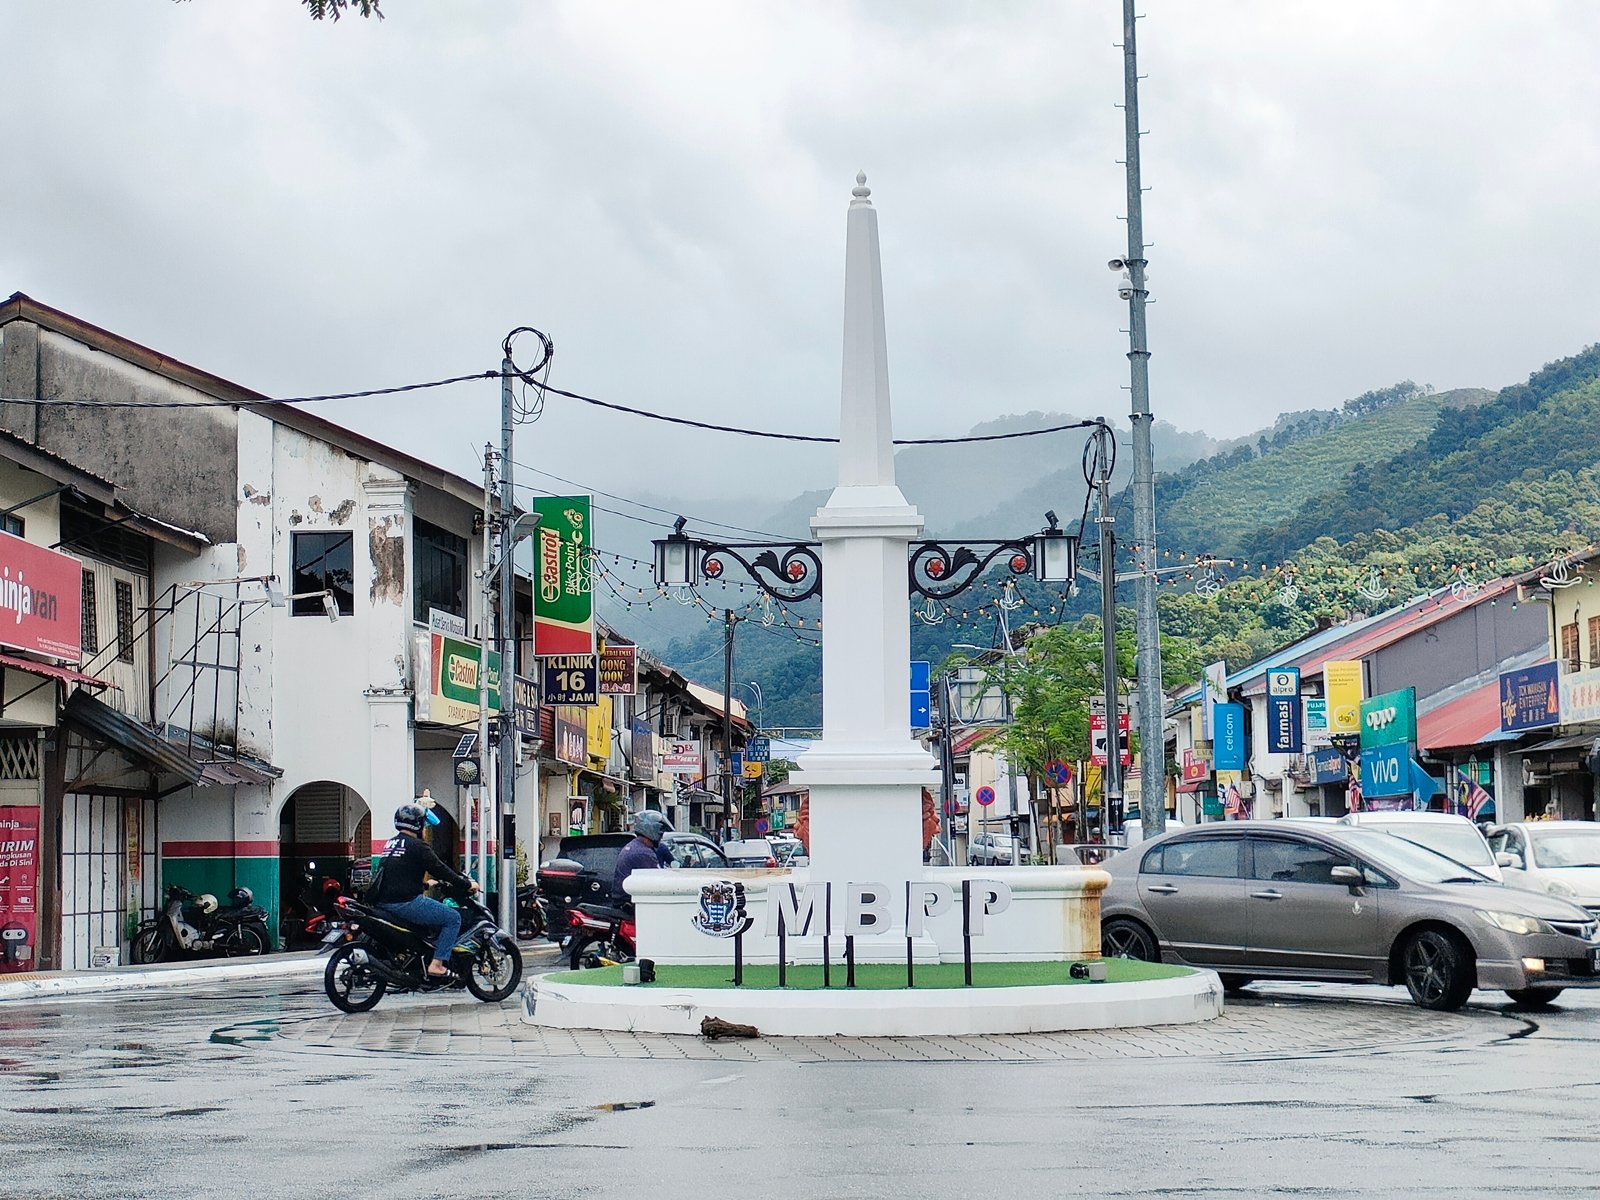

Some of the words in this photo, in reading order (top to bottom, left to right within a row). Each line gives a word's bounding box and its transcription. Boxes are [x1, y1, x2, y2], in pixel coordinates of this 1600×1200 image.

[544, 532, 558, 584] Castrol
[454, 659, 476, 685] Castrol
[547, 655, 594, 669] KLINIK
[556, 671, 586, 691] 16
[1273, 686, 1293, 694] alpro
[547, 693, 566, 702] 小时
[569, 693, 594, 702] JAM
[1276, 701, 1290, 749] farmasi
[1338, 712, 1352, 723] digi
[1366, 707, 1396, 730] oppo
[1225, 713, 1233, 751] celcom
[1371, 752, 1399, 785] vivo
[0, 840, 34, 852] IRIM
[765, 880, 1012, 936] MBPP
